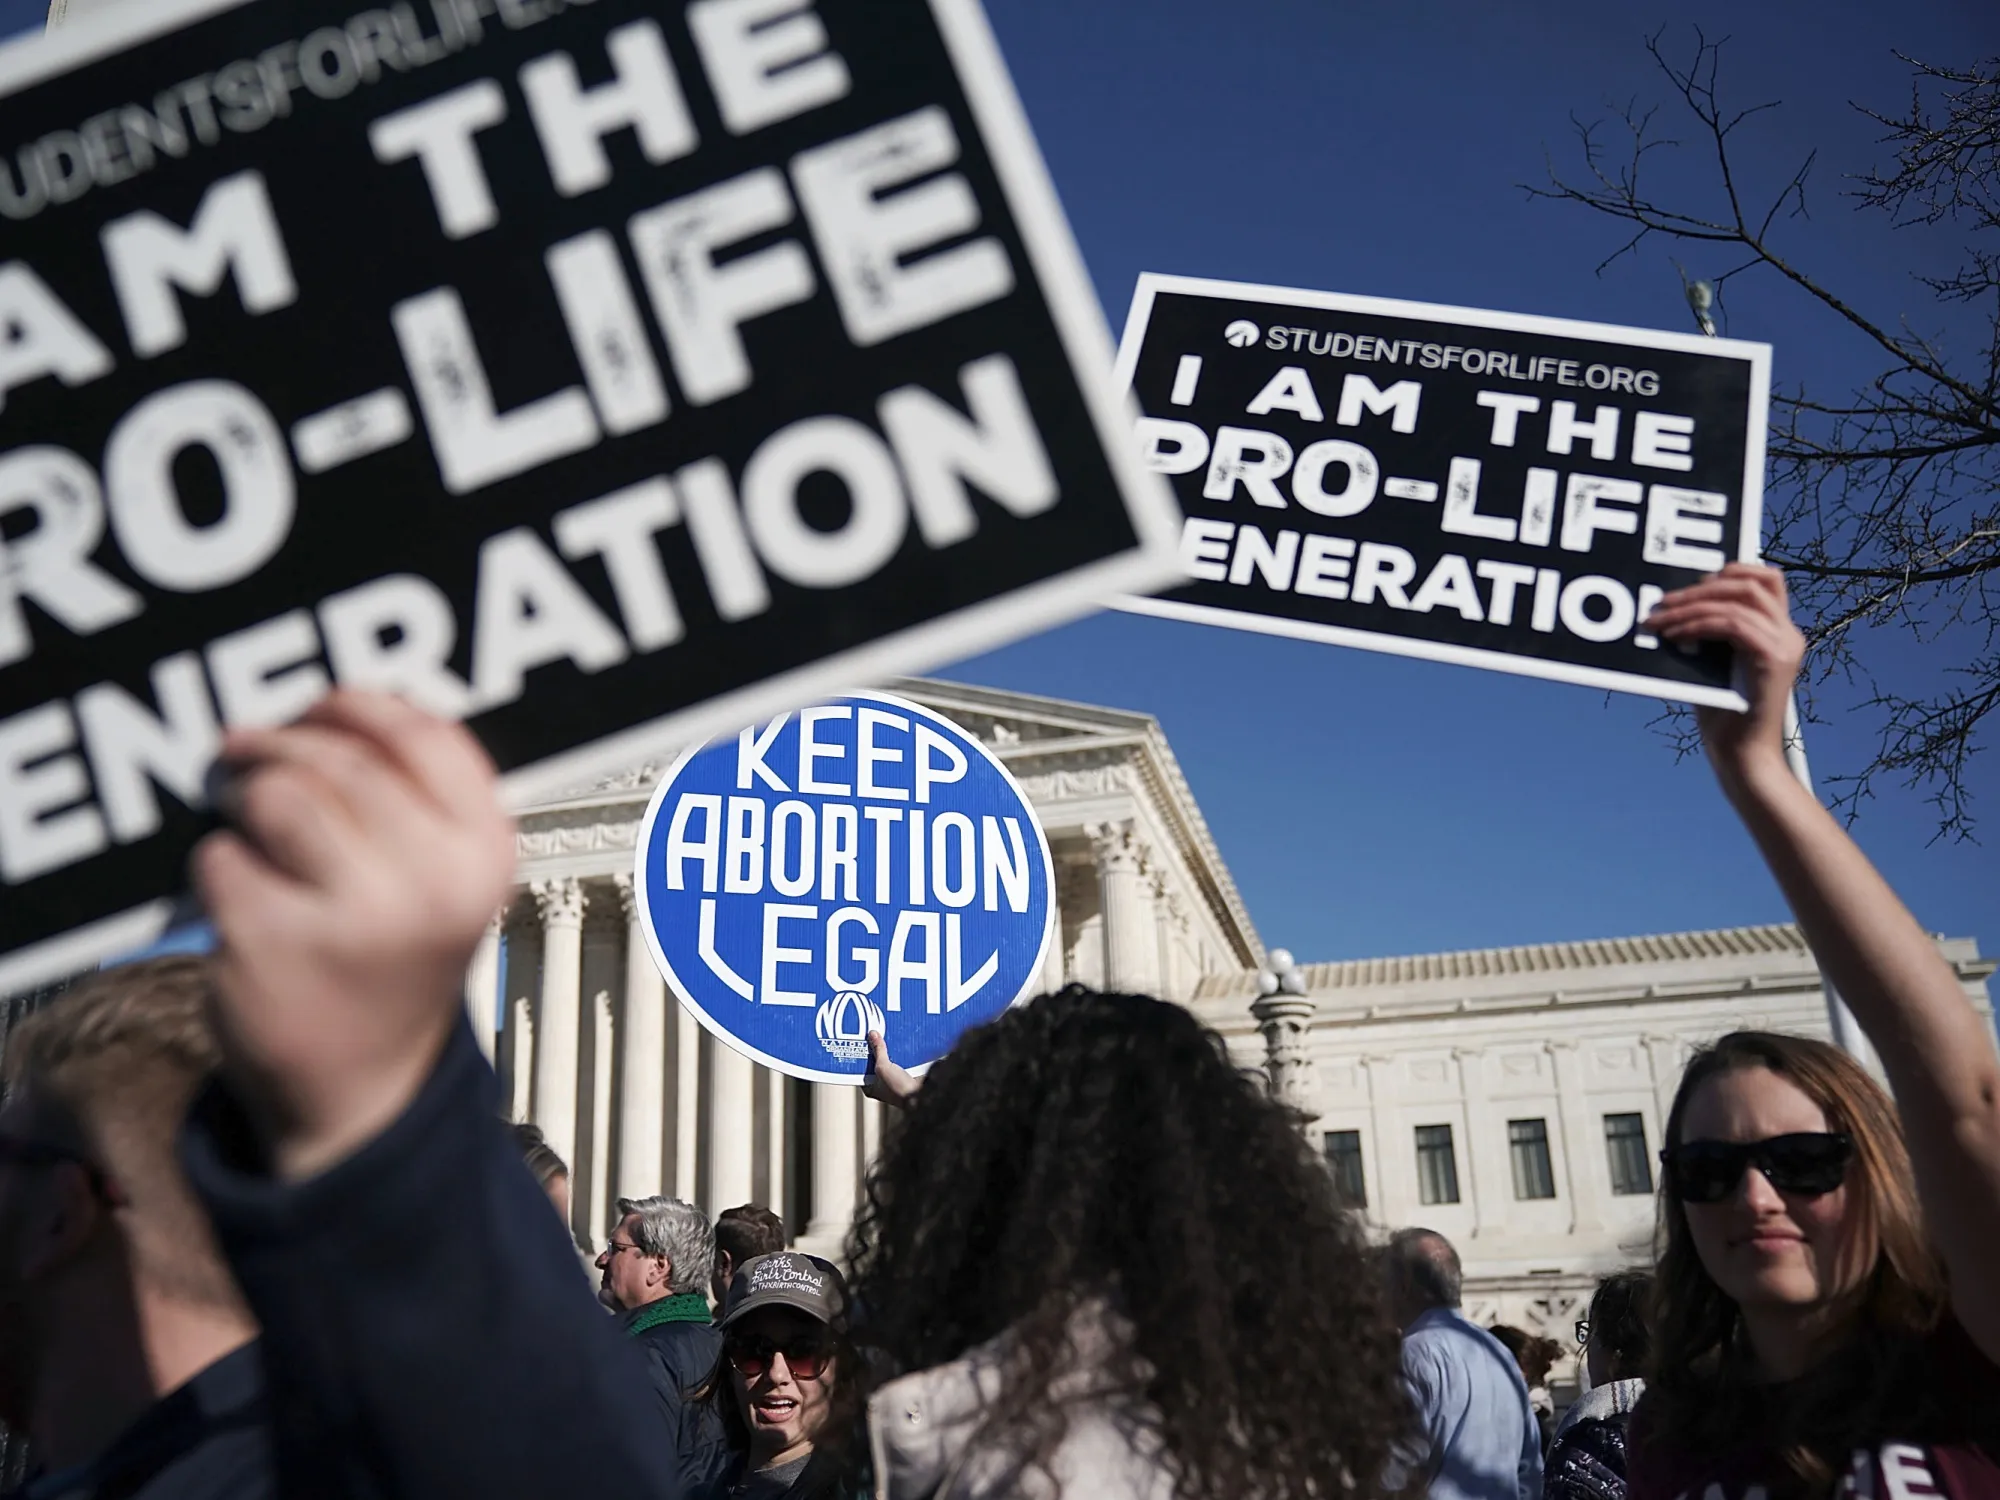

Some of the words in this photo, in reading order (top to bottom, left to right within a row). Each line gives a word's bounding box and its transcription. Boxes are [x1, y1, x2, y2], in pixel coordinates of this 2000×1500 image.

[366, 0, 853, 242] THE
[1170, 354, 1202, 406] I
[1246, 366, 1423, 434] AM
[1476, 390, 1695, 472] THE
[1265, 325, 1660, 397] STUDENTSFORLIFE.ORG
[1133, 416, 1727, 573] PRO-LIFE
[736, 705, 969, 804] KEEP
[666, 792, 1030, 914] ABORTION
[698, 898, 999, 1015] LEGAL
[751, 1267, 782, 1285] Birth
[782, 1268, 823, 1288] Control
